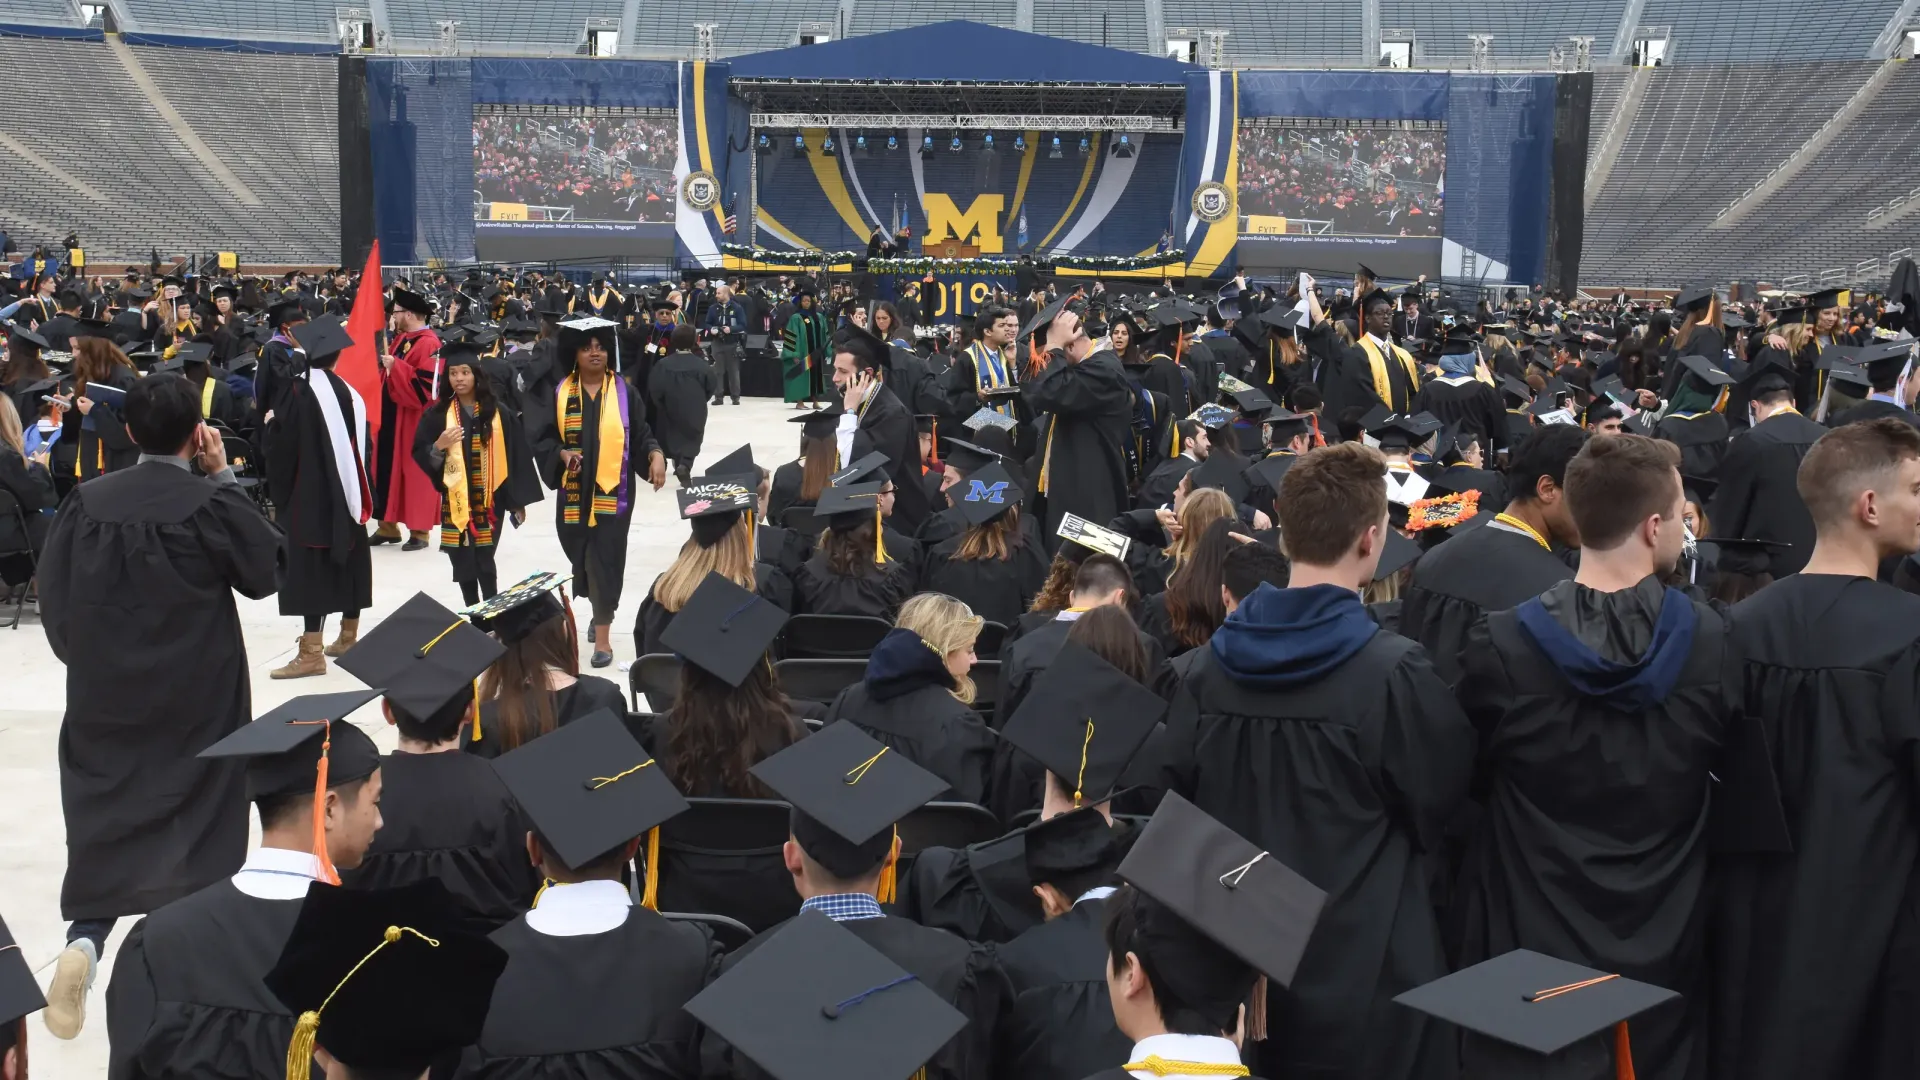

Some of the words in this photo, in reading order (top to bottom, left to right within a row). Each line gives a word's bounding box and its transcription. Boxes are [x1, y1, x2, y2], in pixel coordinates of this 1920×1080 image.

[922, 193, 1004, 253] M
[454, 491, 463, 514] CSP
[965, 480, 1009, 503] M
